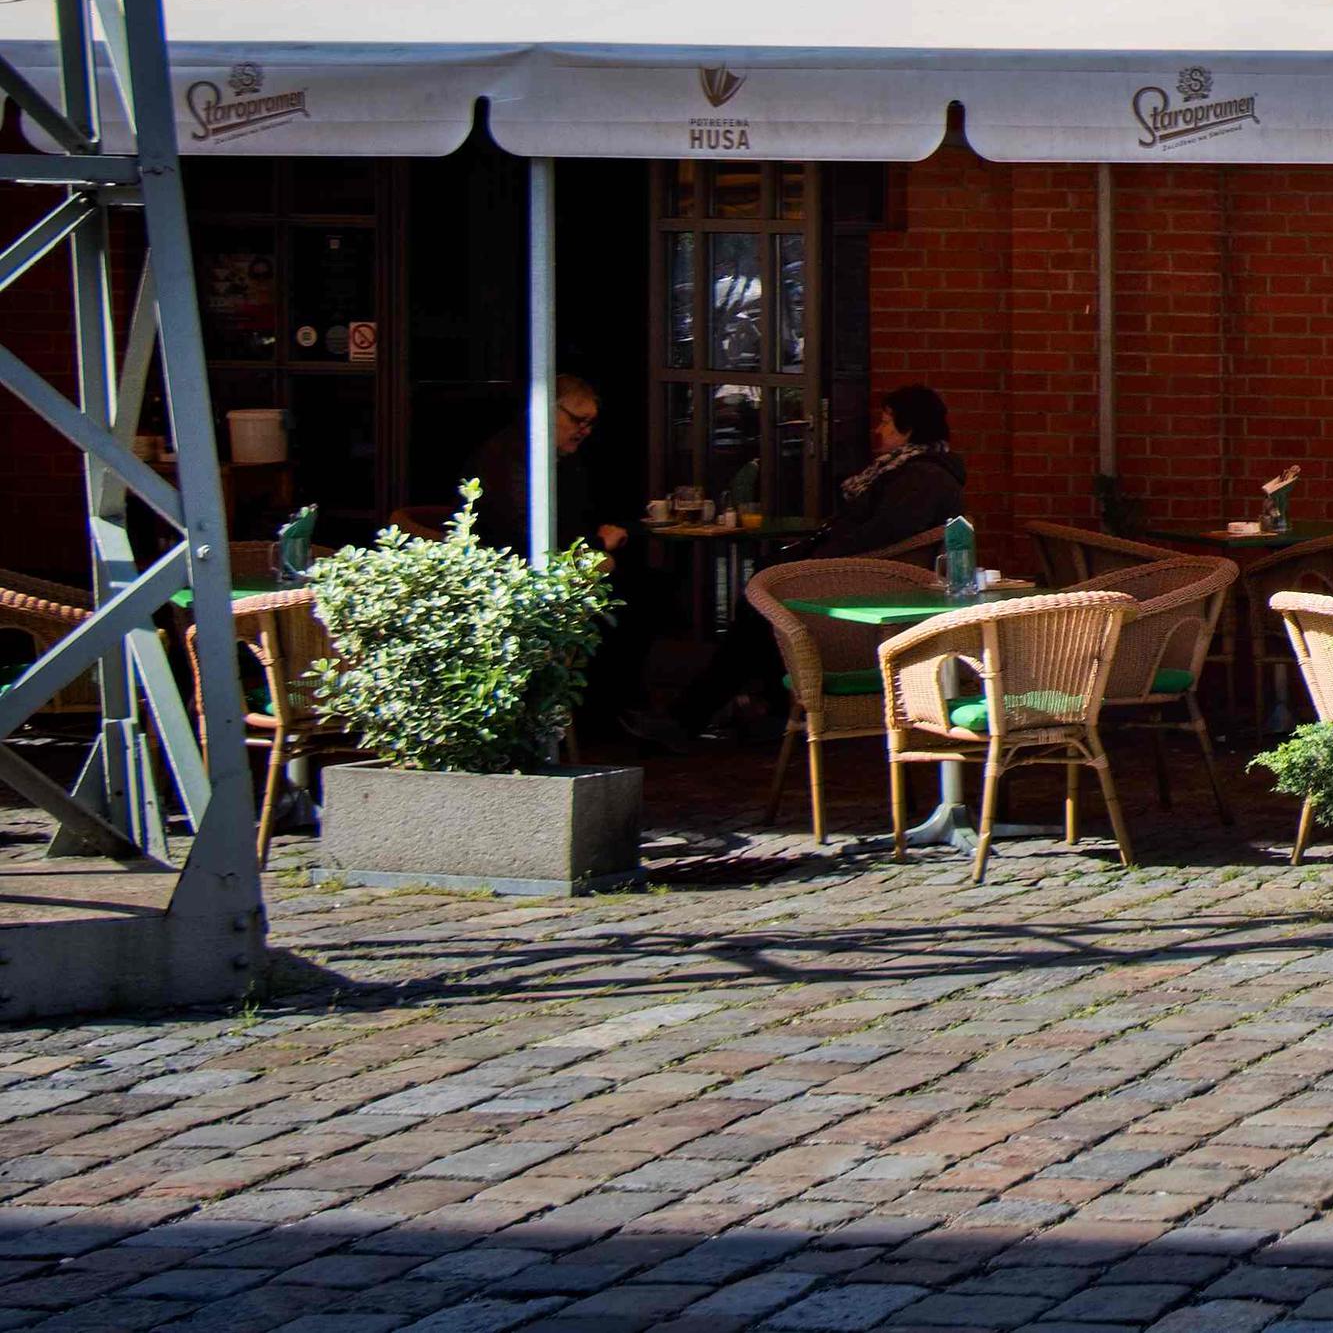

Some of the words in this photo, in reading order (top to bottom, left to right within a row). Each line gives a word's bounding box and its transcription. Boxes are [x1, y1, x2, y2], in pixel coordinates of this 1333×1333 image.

[187, 80, 311, 141] Staropramen
[690, 129, 750, 150] HUSA
[1133, 86, 1260, 148] Staropramen
